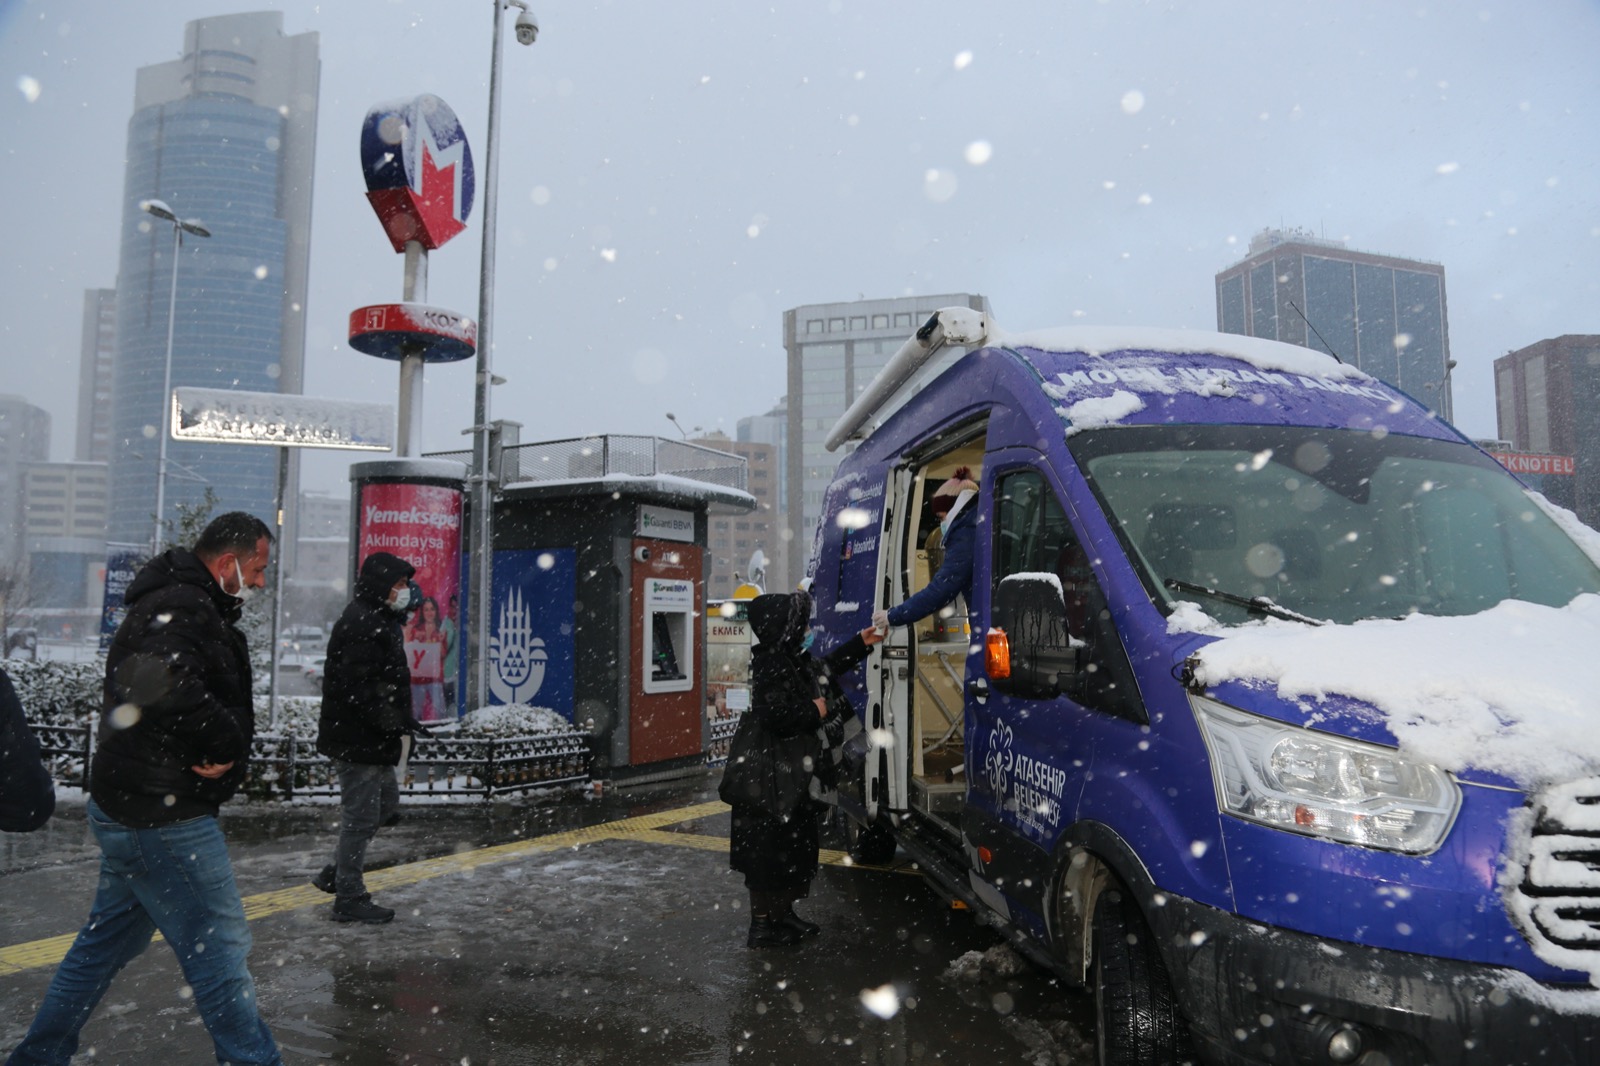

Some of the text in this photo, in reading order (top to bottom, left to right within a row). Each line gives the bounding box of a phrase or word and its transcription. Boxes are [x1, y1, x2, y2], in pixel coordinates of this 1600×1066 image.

[673, 519, 692, 531] BBVA
[365, 534, 444, 551] Aklındaysa
[712, 626, 745, 636] EKMEK
